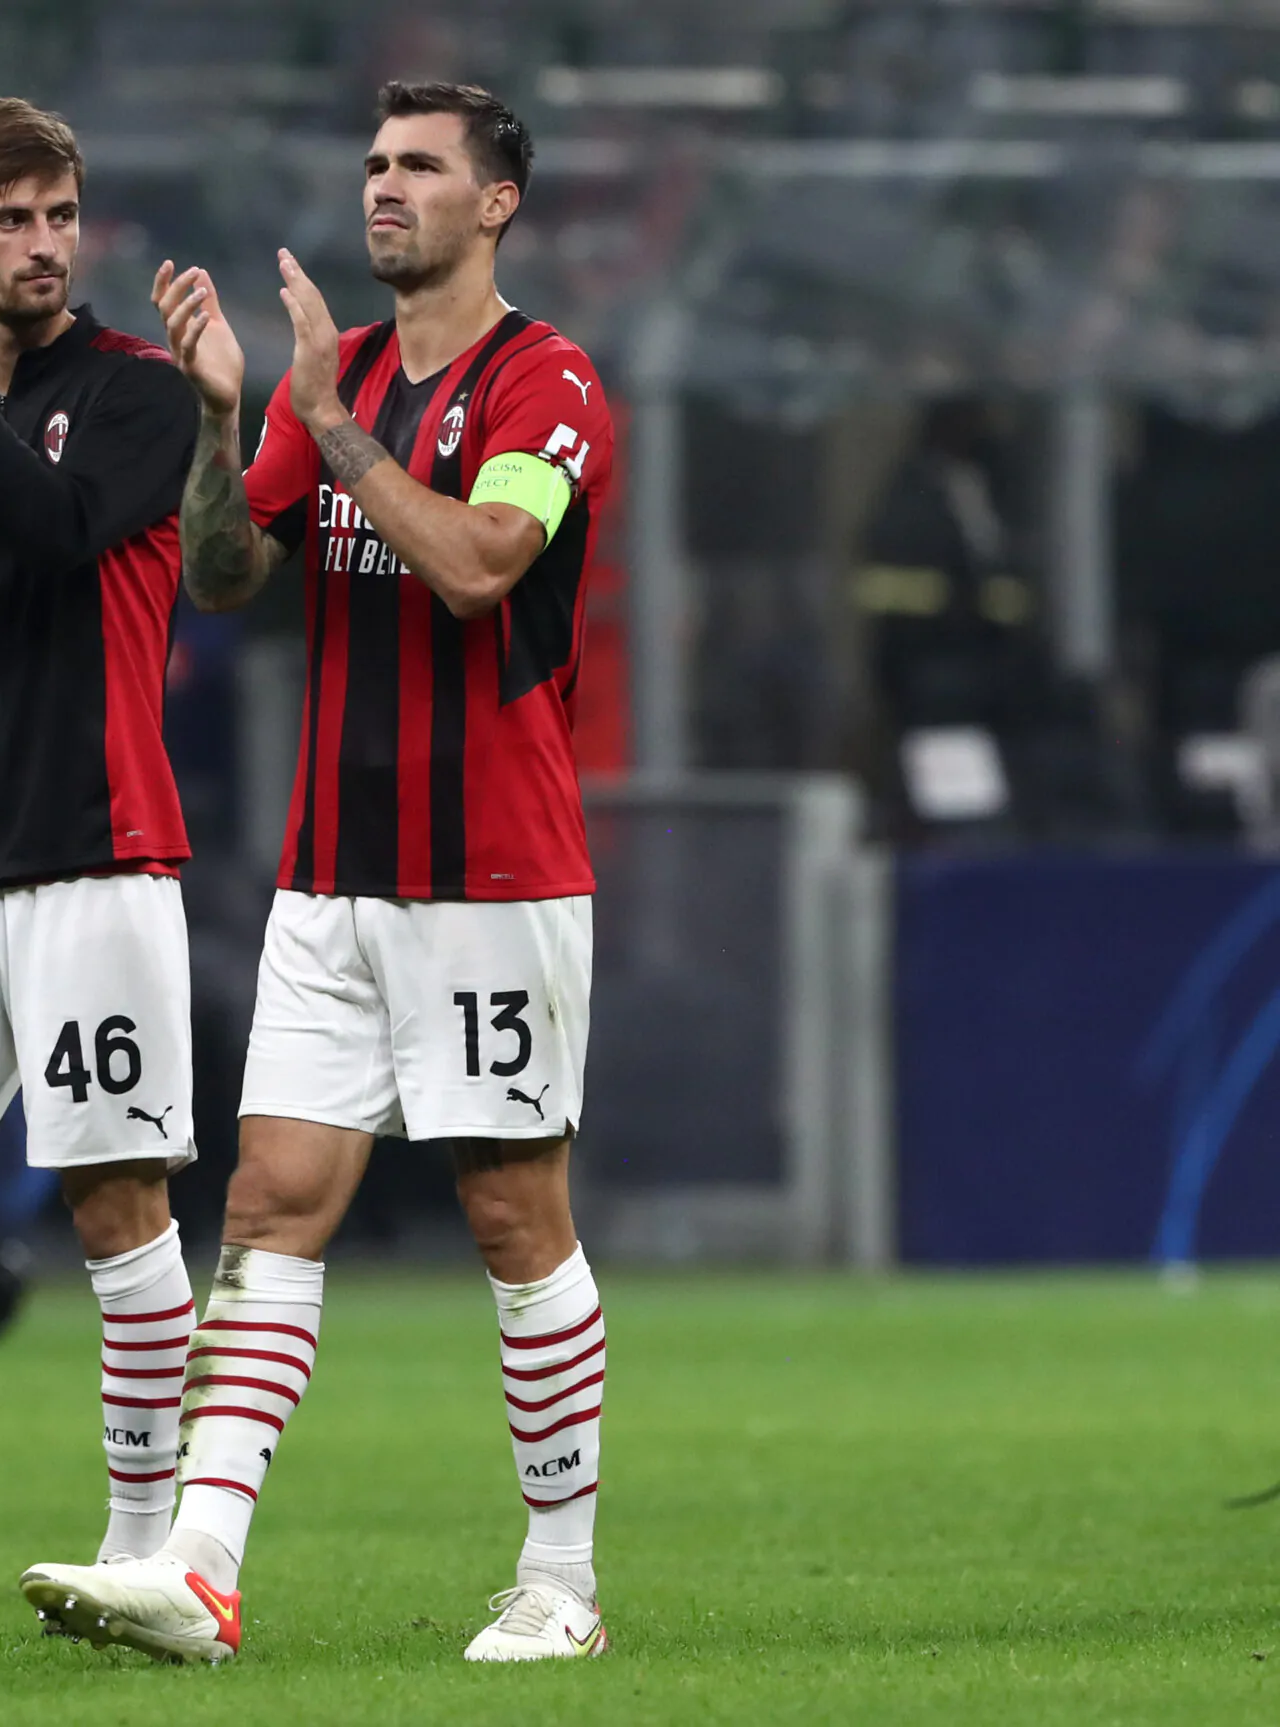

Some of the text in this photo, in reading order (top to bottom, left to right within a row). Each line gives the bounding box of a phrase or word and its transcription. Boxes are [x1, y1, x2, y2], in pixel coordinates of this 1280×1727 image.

[325, 536, 356, 572] FLY
[453, 989, 532, 1077] 13
[44, 1014, 142, 1103] 46
[103, 1426, 151, 1448] ACM
[525, 1448, 581, 1477] ACM
